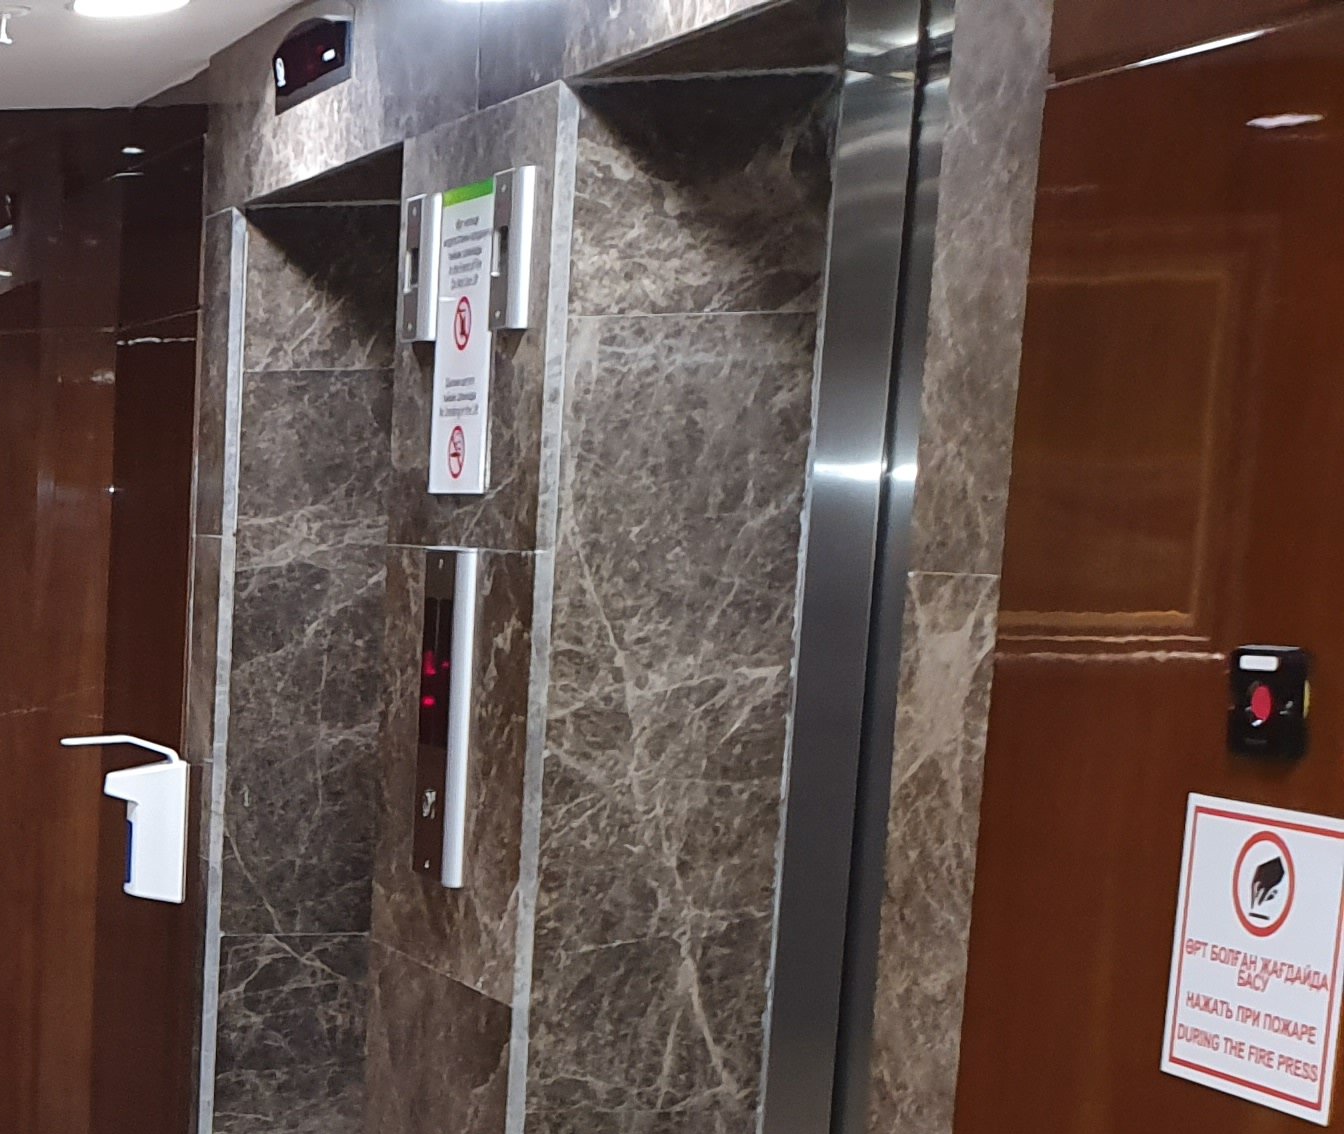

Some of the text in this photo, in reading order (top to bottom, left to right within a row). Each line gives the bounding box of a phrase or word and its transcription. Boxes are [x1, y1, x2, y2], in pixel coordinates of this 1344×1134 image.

[1237, 969, 1271, 992] БАСУ
[1186, 991, 1317, 1045] НАЖАТЬ ПРИ ПОЖАРЕ
[1177, 1022, 1319, 1083] DURING THE FIRE PRESS
